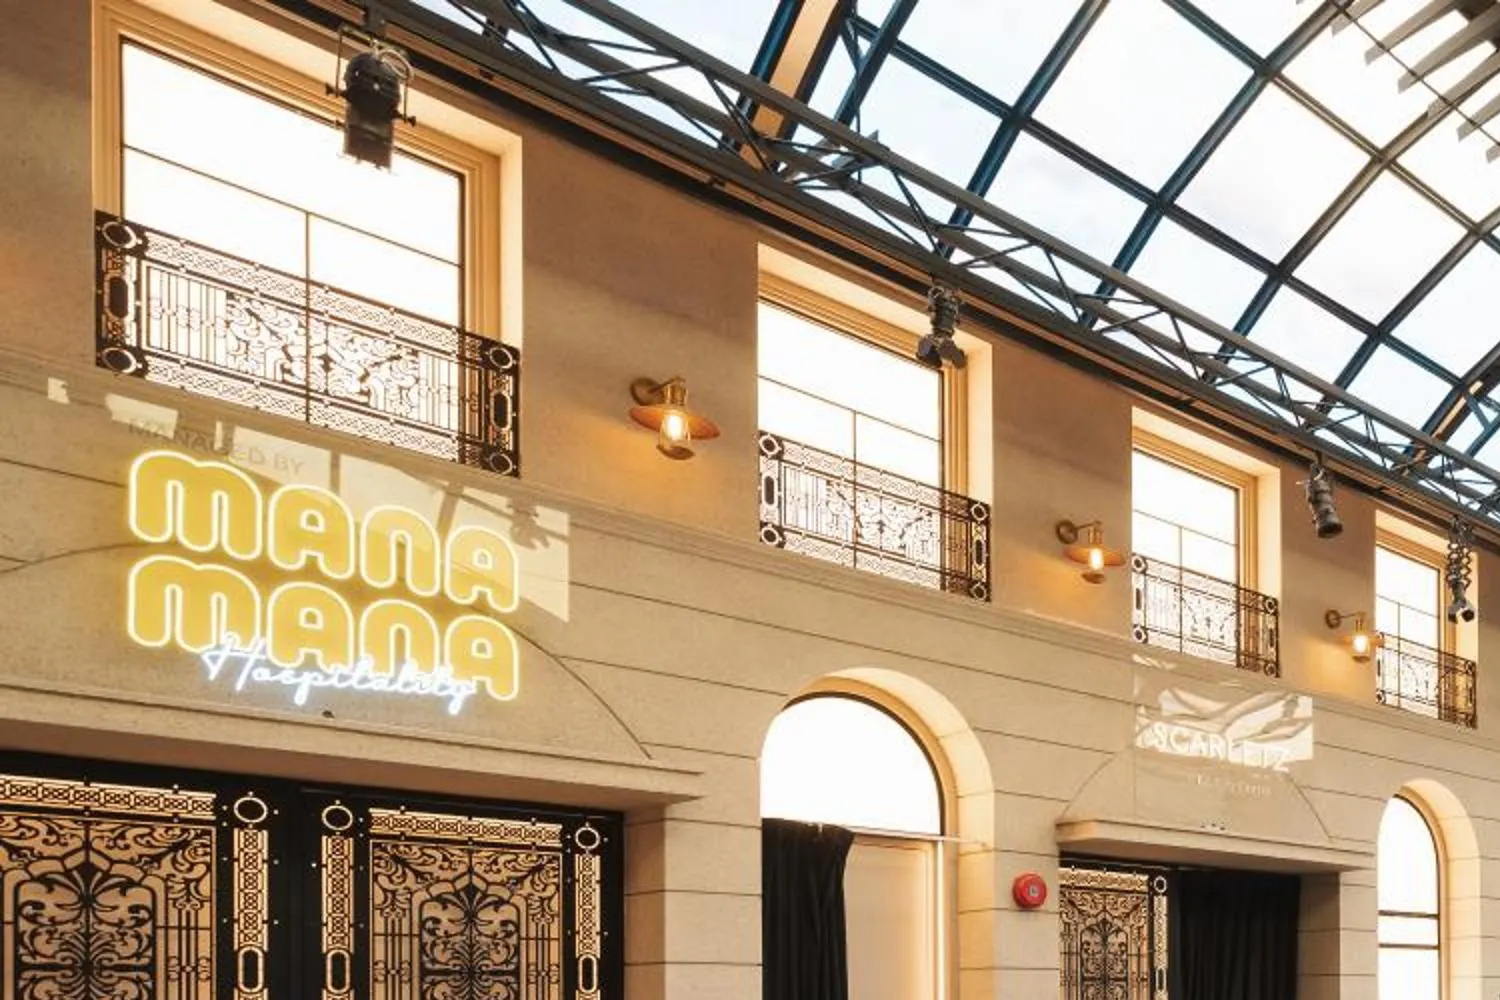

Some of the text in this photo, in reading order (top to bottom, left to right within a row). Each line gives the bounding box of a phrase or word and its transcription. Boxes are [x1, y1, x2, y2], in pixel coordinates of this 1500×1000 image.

[128, 417, 305, 477] MANAGED BY
[128, 449, 520, 613] MANA
[126, 555, 520, 702] MANA
[199, 630, 477, 716] Hospitality
